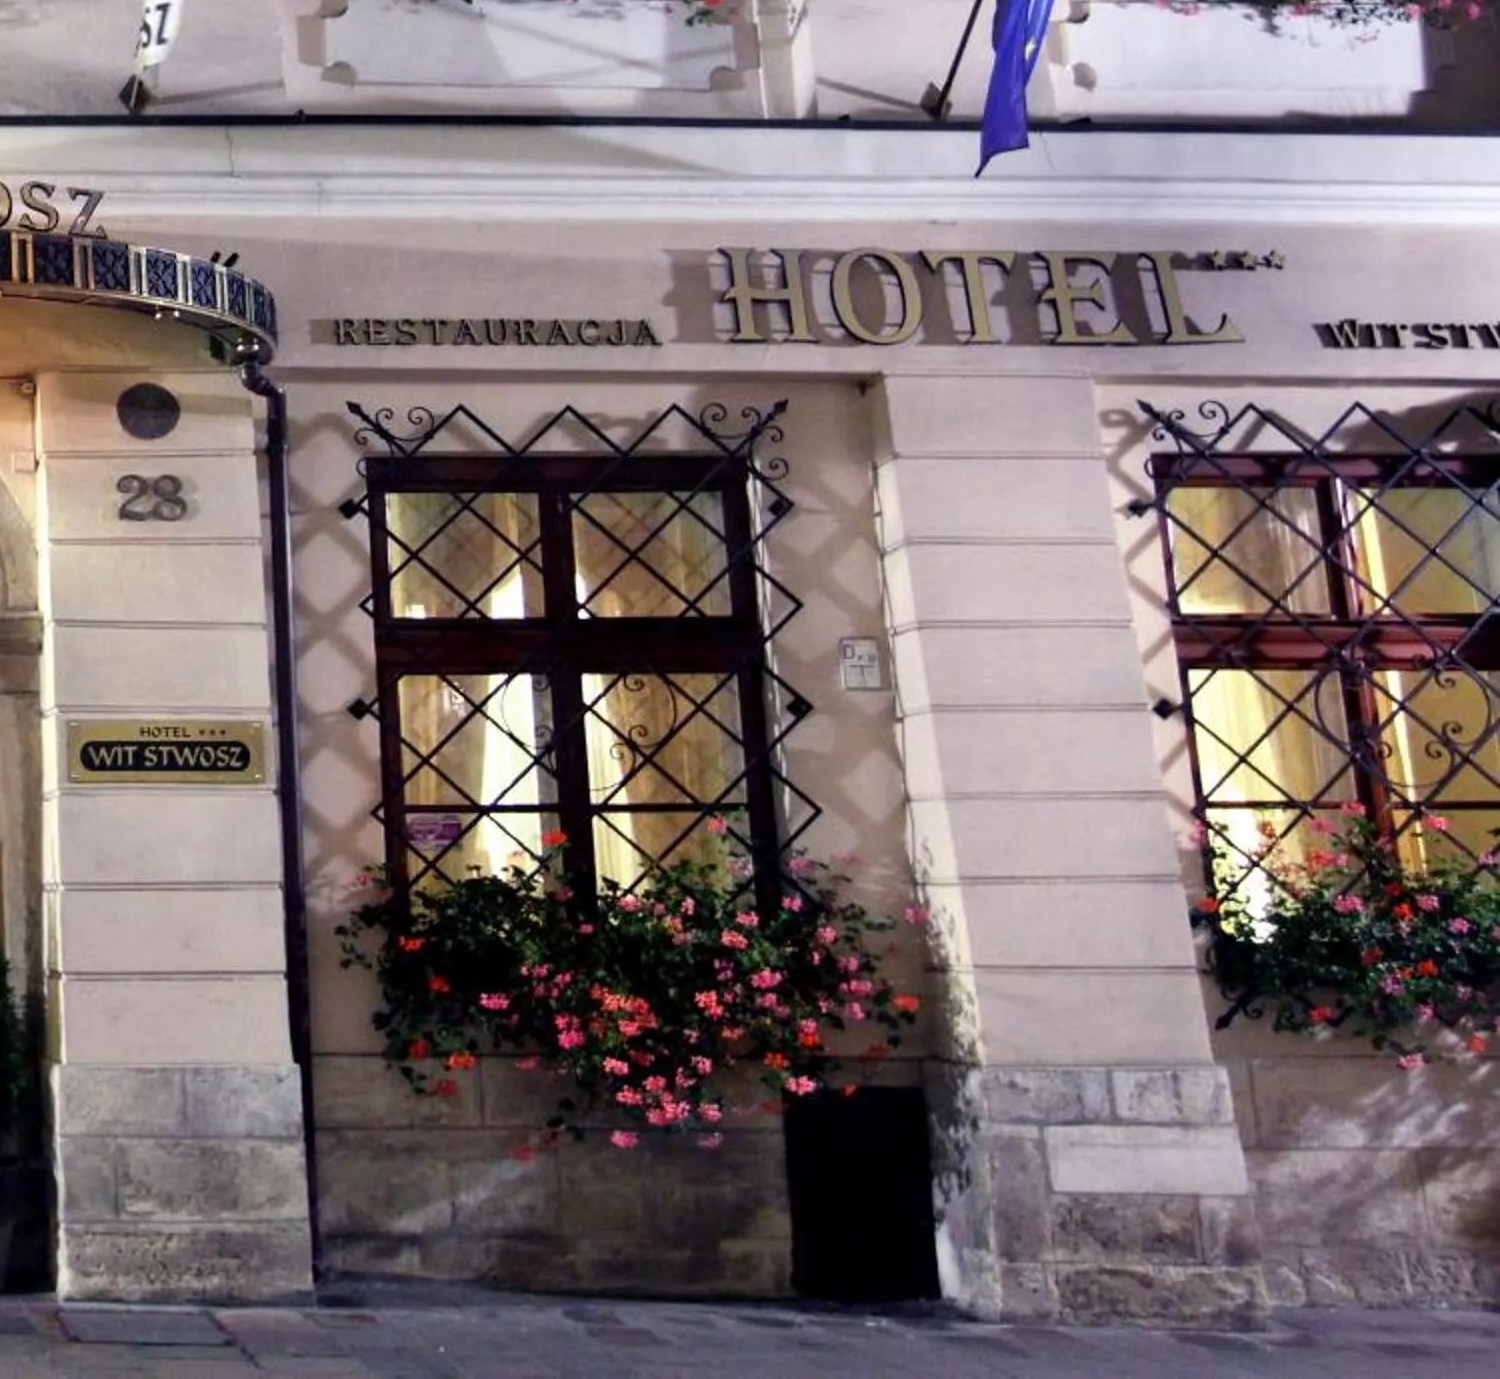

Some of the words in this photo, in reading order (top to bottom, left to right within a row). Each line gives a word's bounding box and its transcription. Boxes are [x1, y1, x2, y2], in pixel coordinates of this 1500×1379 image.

[717, 247, 1246, 346] HOTEL
[334, 318, 663, 347] RESTAURACJA
[1326, 318, 1409, 349] WIT
[116, 474, 188, 521] 28
[139, 726, 191, 739] HOTEL
[87, 744, 139, 767] WIT
[143, 744, 244, 768] STWOSZ
